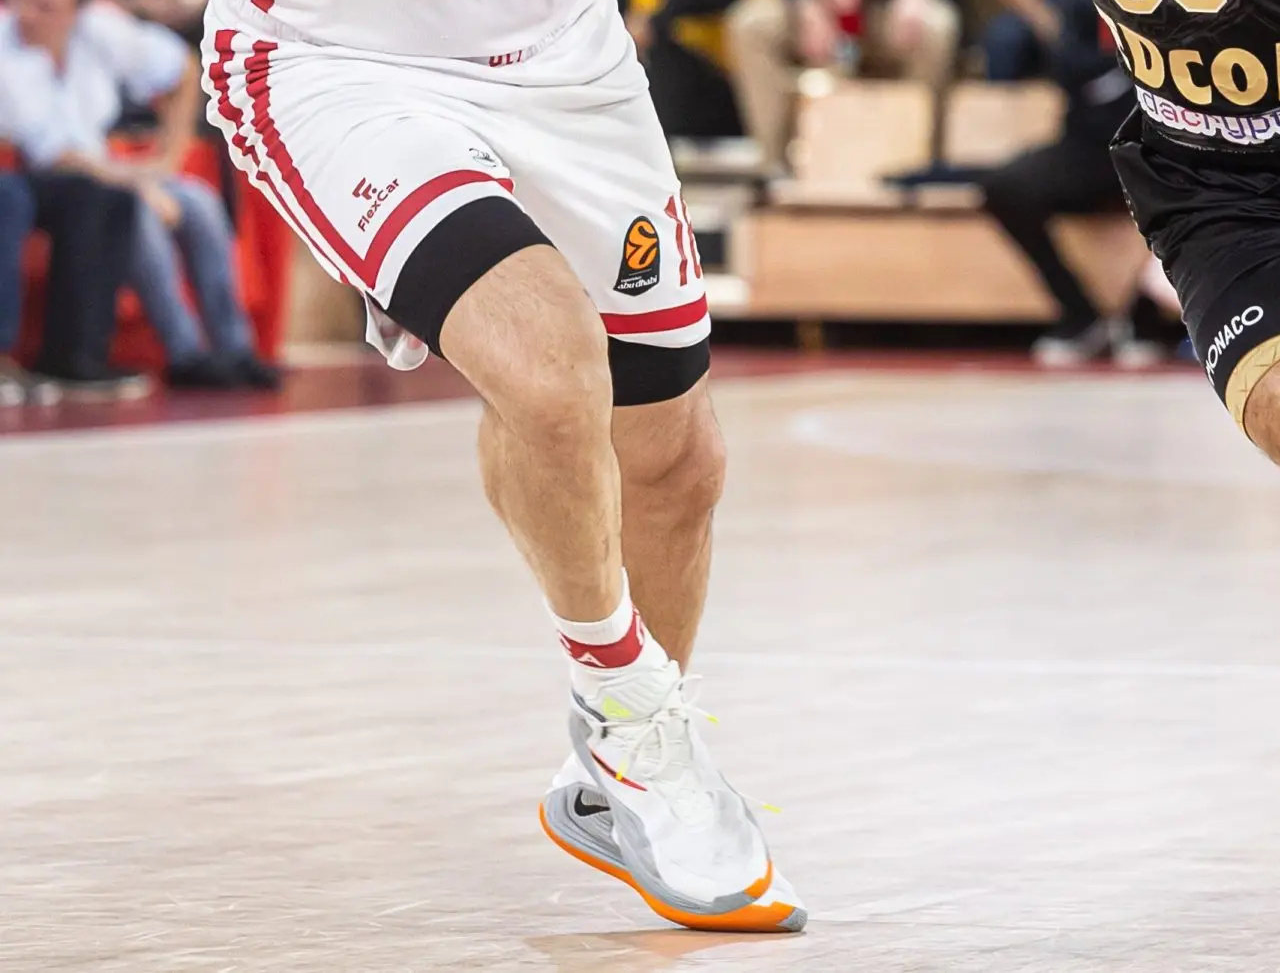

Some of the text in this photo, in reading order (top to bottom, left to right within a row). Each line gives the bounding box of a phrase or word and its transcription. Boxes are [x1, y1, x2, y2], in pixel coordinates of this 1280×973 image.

[357, 178, 400, 233] FlexCar
[617, 281, 635, 290] abu
[635, 275, 658, 287] dhabi
